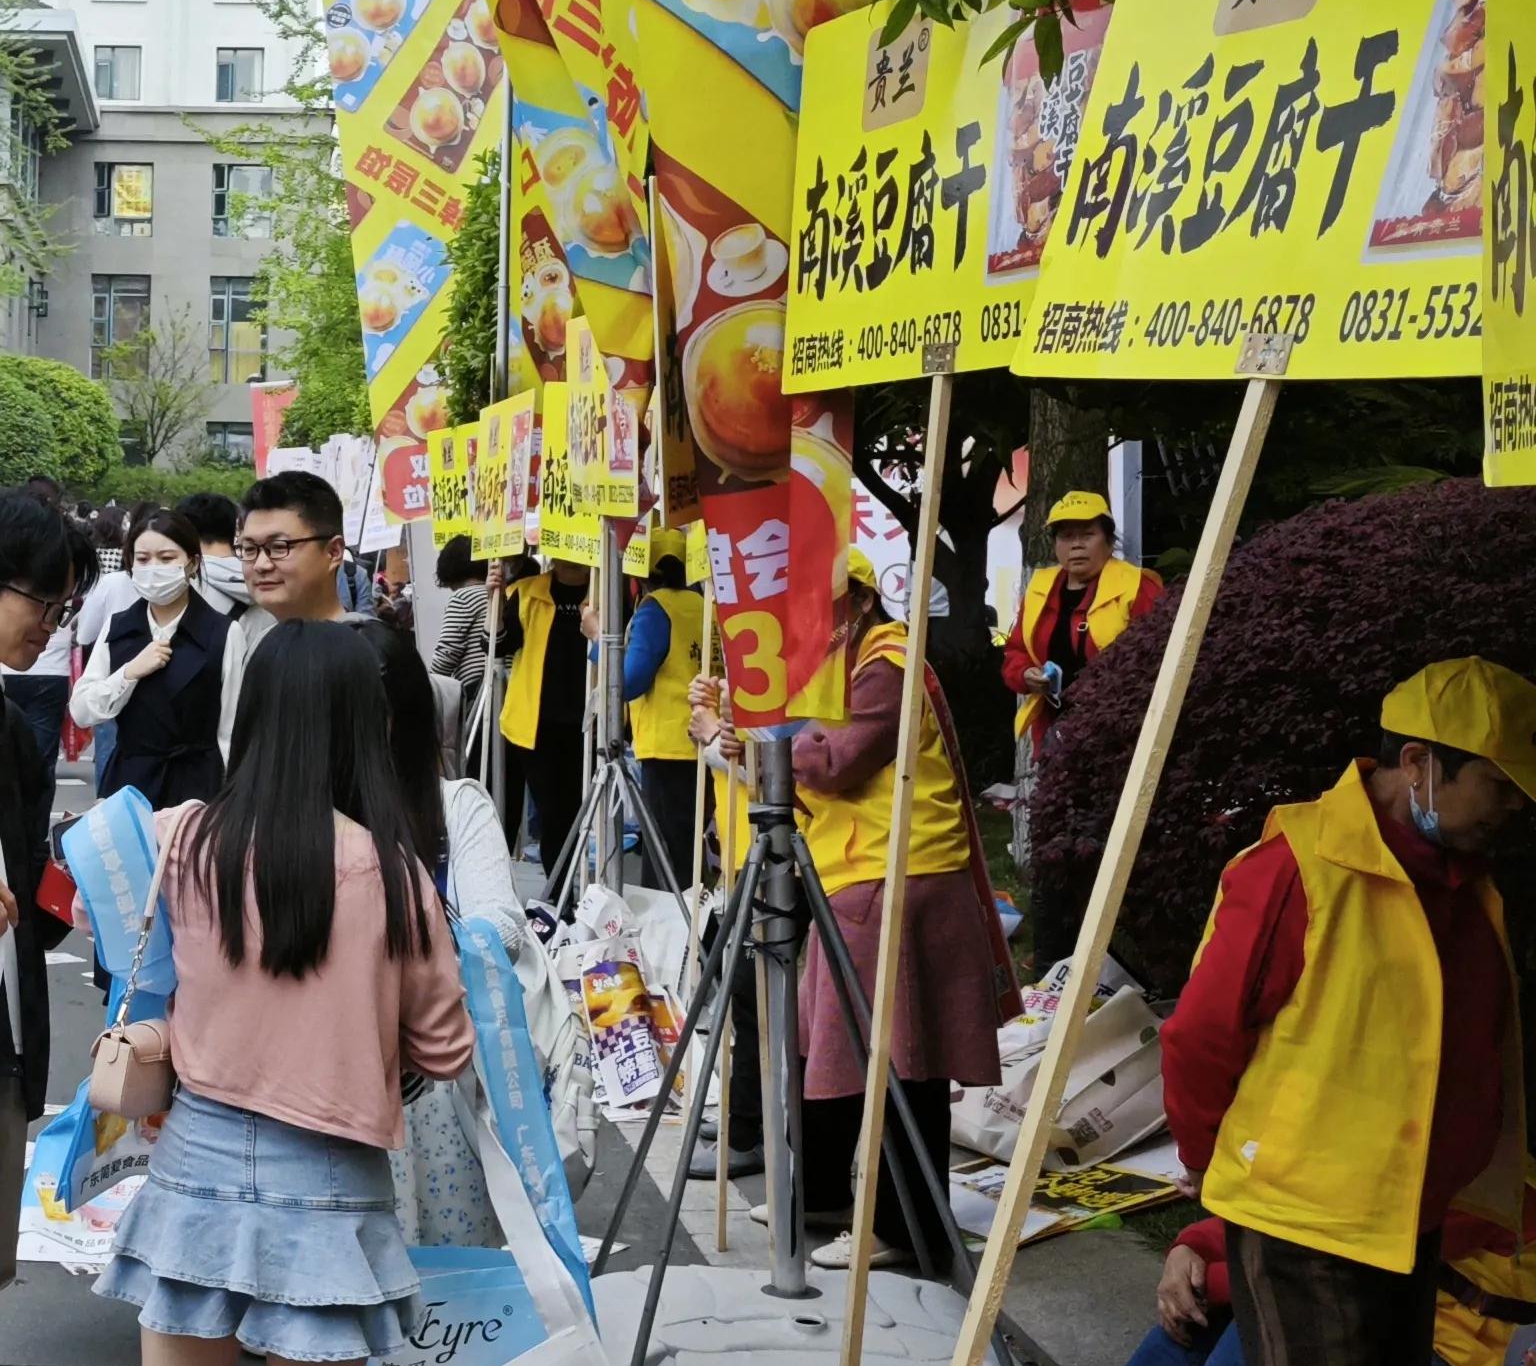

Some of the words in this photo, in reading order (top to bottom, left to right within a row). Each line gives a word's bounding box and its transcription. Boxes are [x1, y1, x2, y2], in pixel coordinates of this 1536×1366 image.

[796, 119, 987, 302] 南溪豆腐干
[1064, 29, 1399, 261] 南溪豆腐干
[723, 610, 788, 713] 3
[80, 1154, 150, 1196] 广东简爱食品
